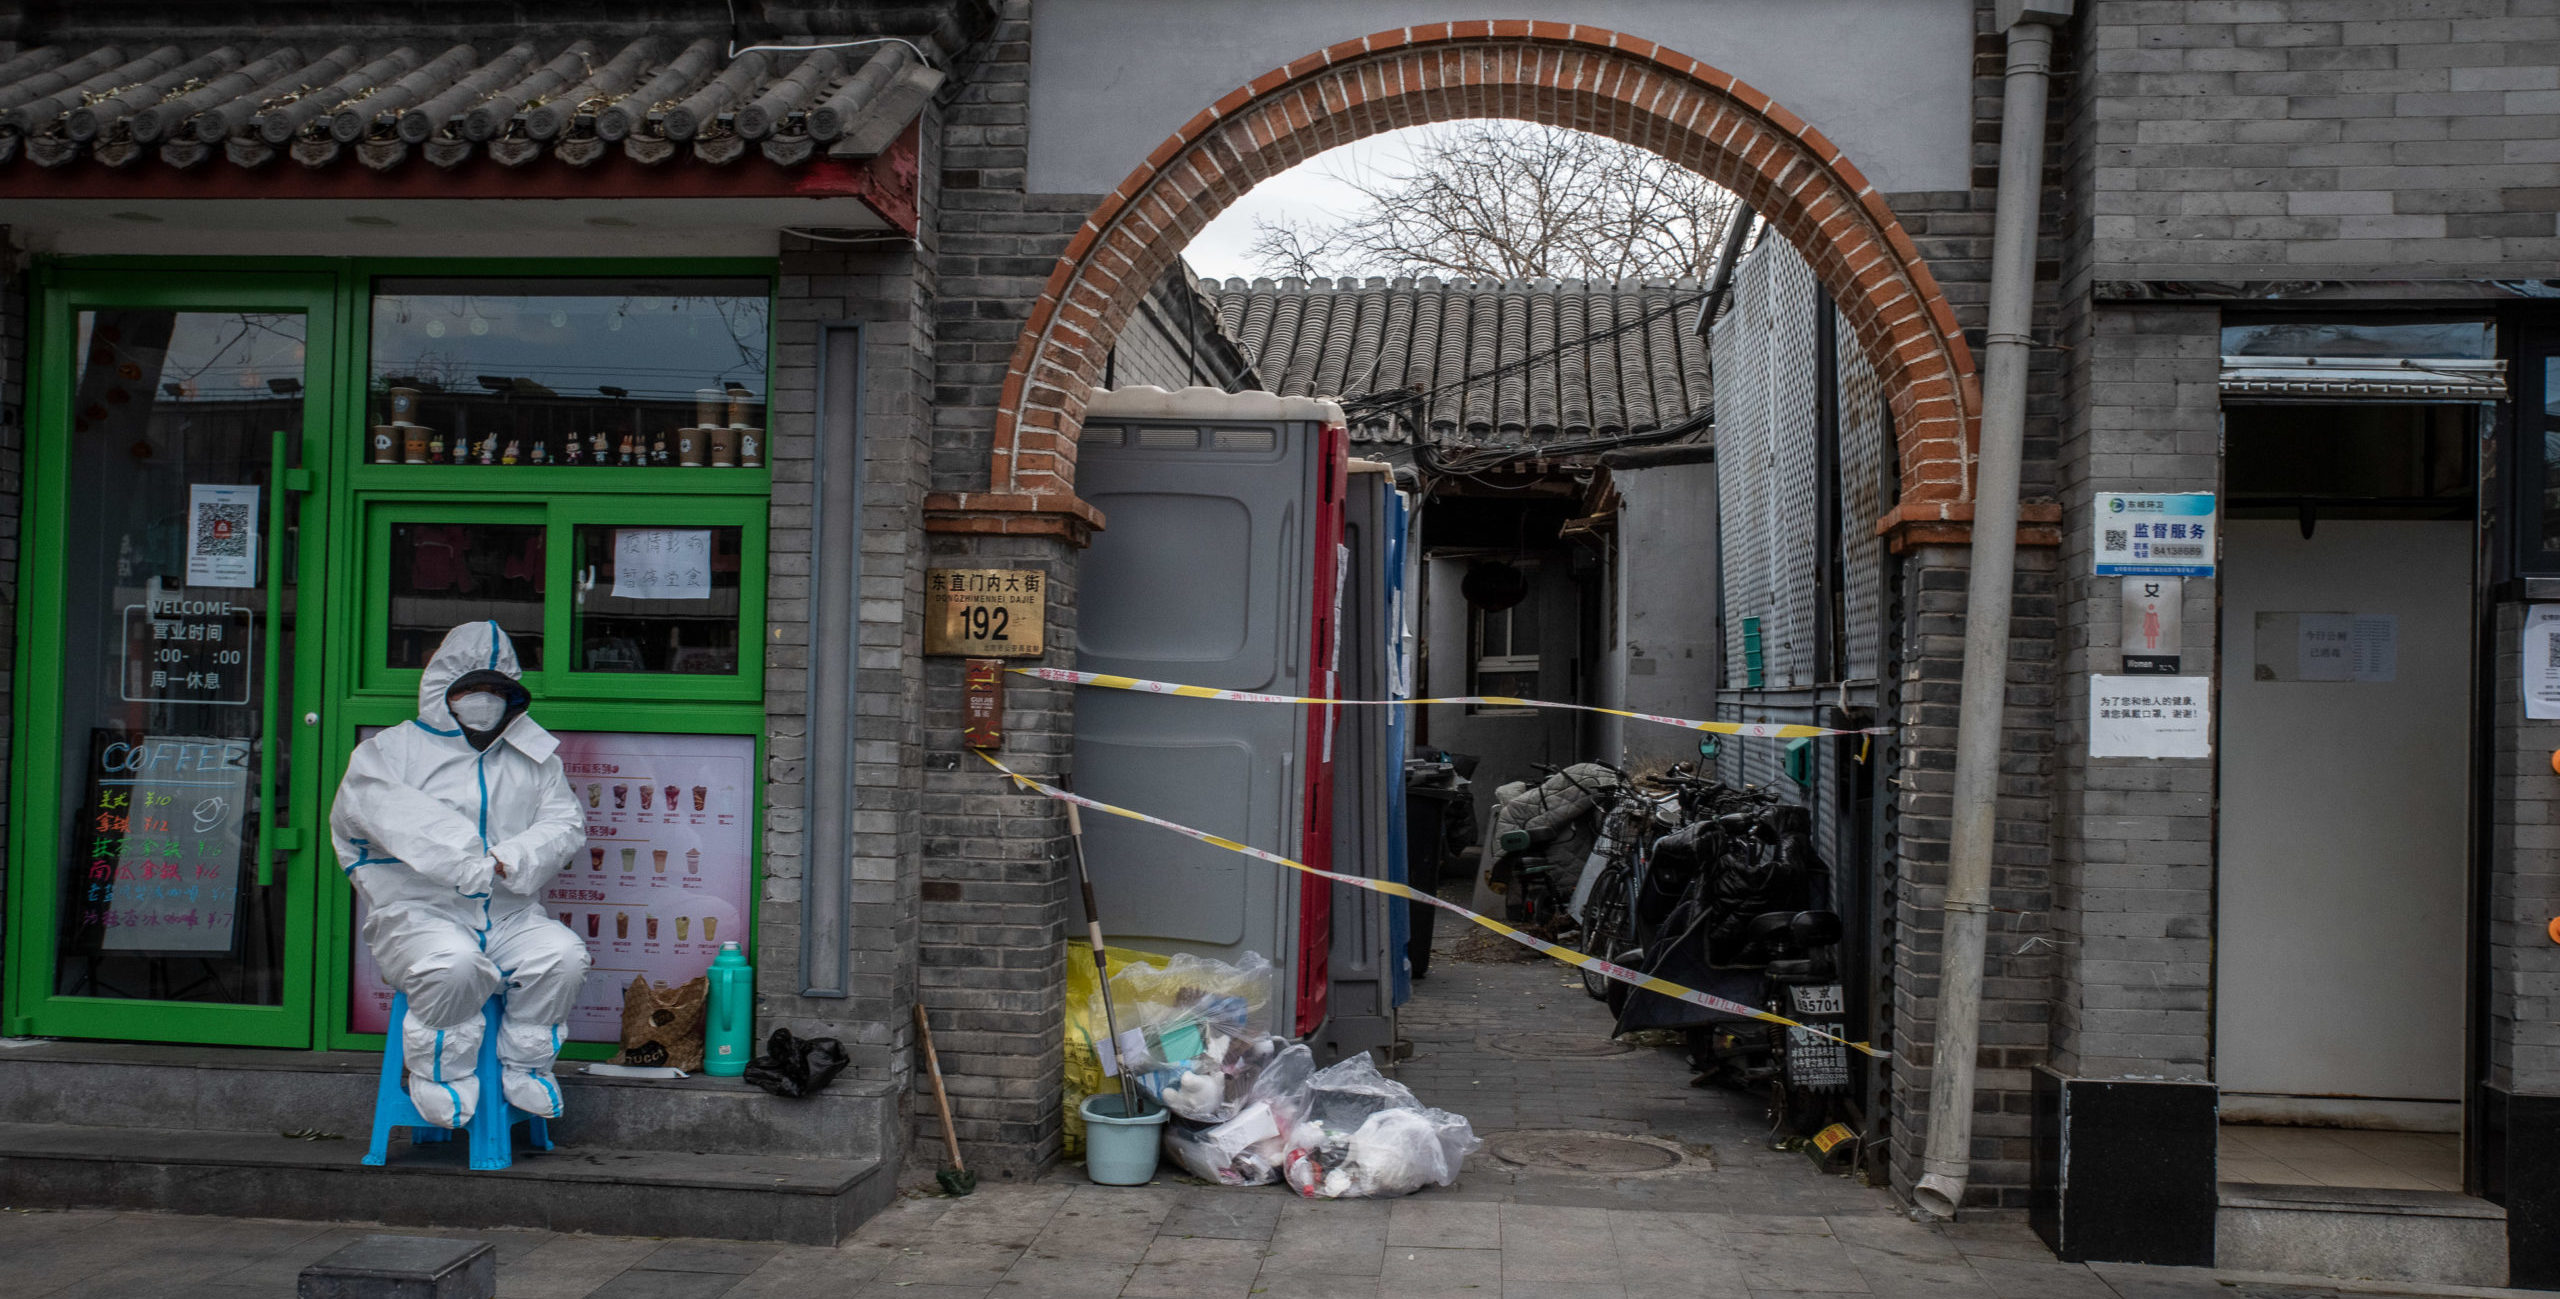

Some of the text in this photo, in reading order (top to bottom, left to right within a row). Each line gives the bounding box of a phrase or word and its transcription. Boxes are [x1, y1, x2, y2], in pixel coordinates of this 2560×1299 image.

[2133, 523, 2205, 539] 监督服务
[932, 574, 1040, 593] 东直门内大街
[2144, 583, 2159, 598] 女
[149, 600, 231, 615] WELCOME
[935, 594, 1035, 604] DONGZHIMENNEI DAJIE
[153, 623, 223, 641] 营业时间
[960, 605, 1009, 641] 192
[150, 671, 221, 689] 周一休息
[102, 742, 249, 773] COFFEE
